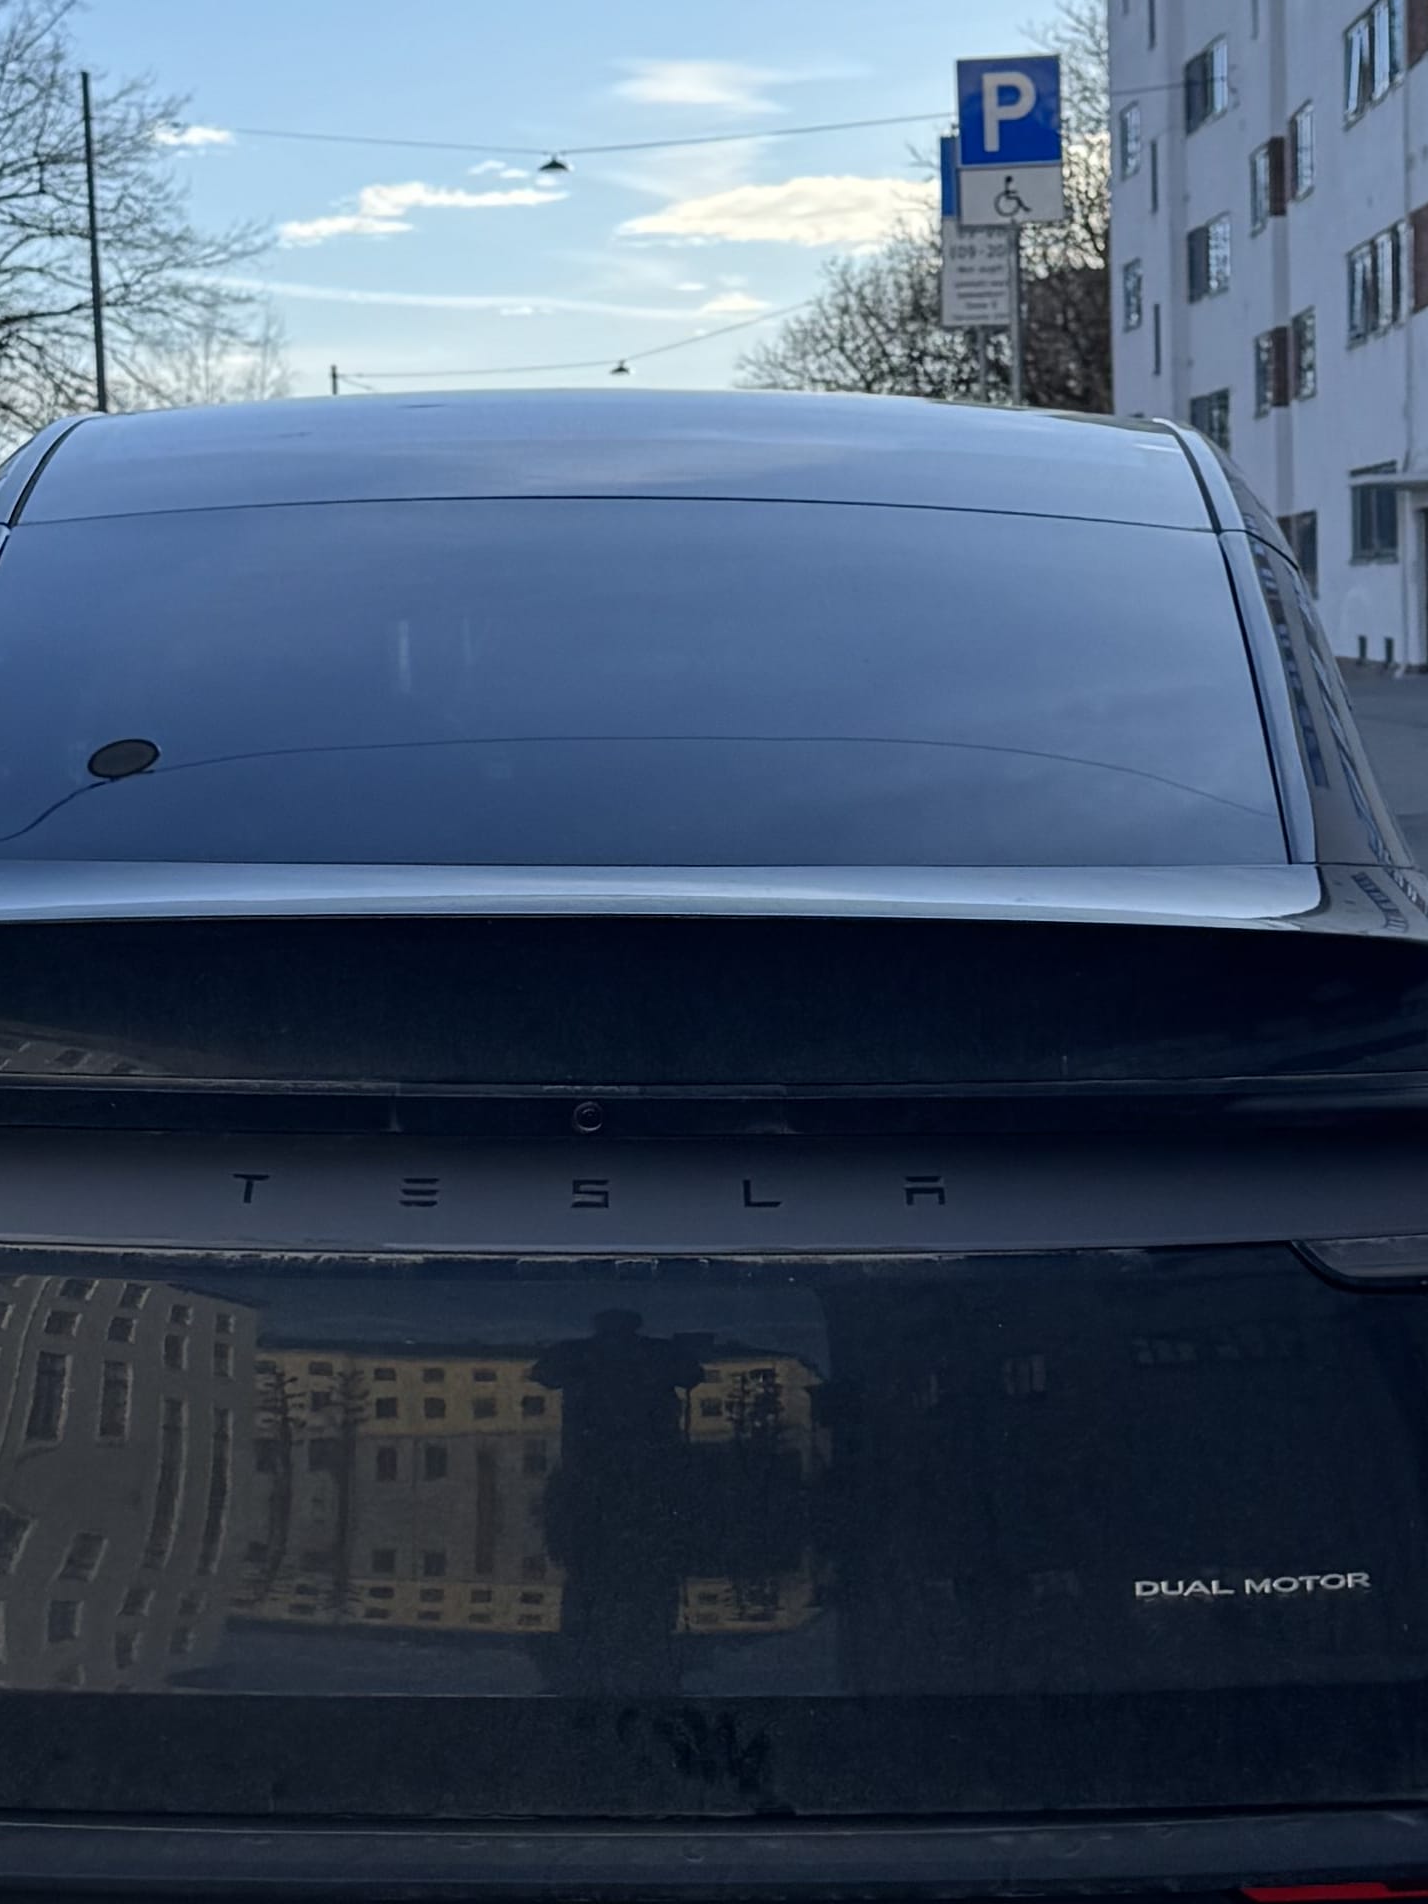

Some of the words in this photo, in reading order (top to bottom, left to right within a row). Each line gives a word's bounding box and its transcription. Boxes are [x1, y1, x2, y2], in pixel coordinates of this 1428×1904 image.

[982, 72, 1036, 152] P
[232, 1173, 947, 1208] TESLA
[1134, 1580, 1235, 1596] DUAL
[1244, 1571, 1371, 1594] MOTOR
